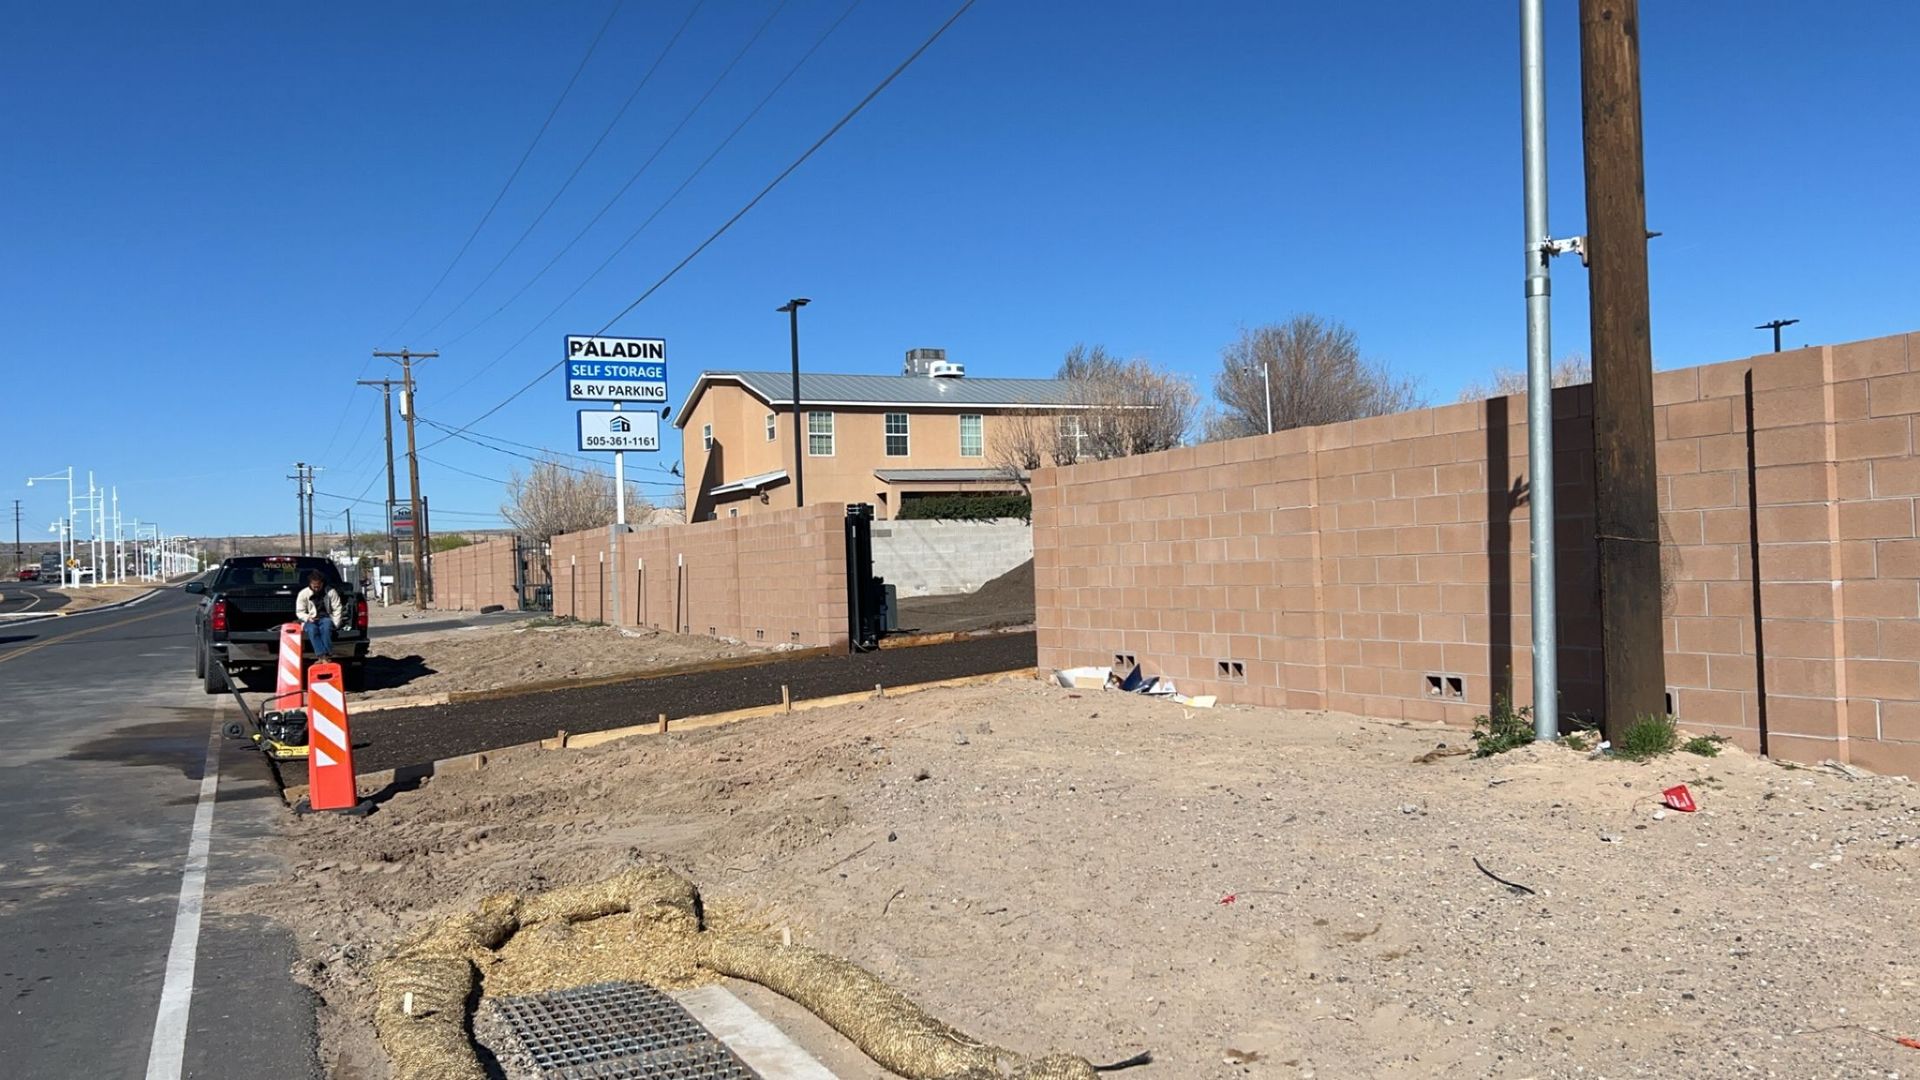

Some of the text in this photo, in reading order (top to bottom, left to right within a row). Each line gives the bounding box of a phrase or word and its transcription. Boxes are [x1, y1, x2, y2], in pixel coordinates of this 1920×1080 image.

[570, 341, 663, 359] PALADIN
[572, 364, 663, 378] SELF STORAGE
[573, 384, 664, 397] & RV PARKING
[587, 436, 655, 446] 505-361-1161
